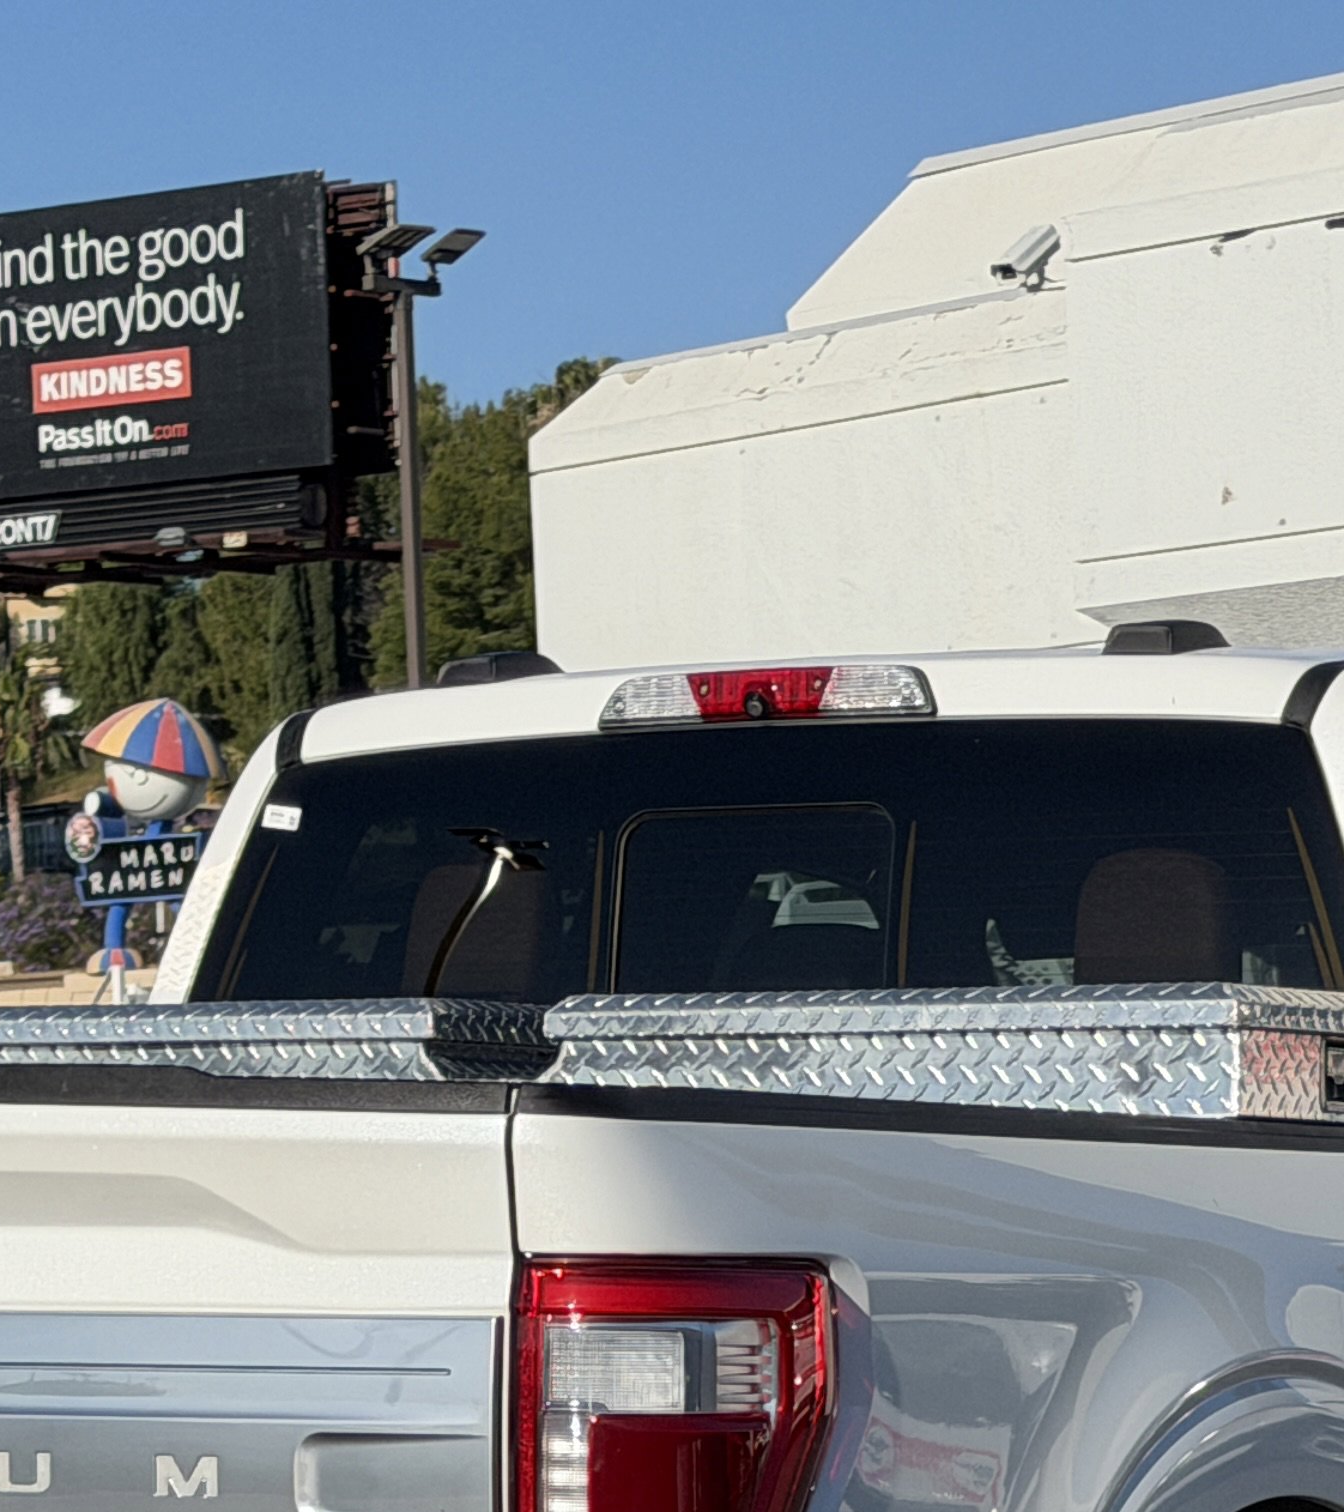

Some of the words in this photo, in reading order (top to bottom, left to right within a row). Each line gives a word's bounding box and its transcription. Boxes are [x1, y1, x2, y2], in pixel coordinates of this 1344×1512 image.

[60, 228, 130, 280] the
[138, 207, 244, 282] good
[26, 273, 245, 347] everybody.
[40, 358, 183, 403] KINDNESS
[38, 415, 189, 453] PassItOn.com
[120, 842, 194, 869] MARU
[88, 867, 185, 896] RAMEN
